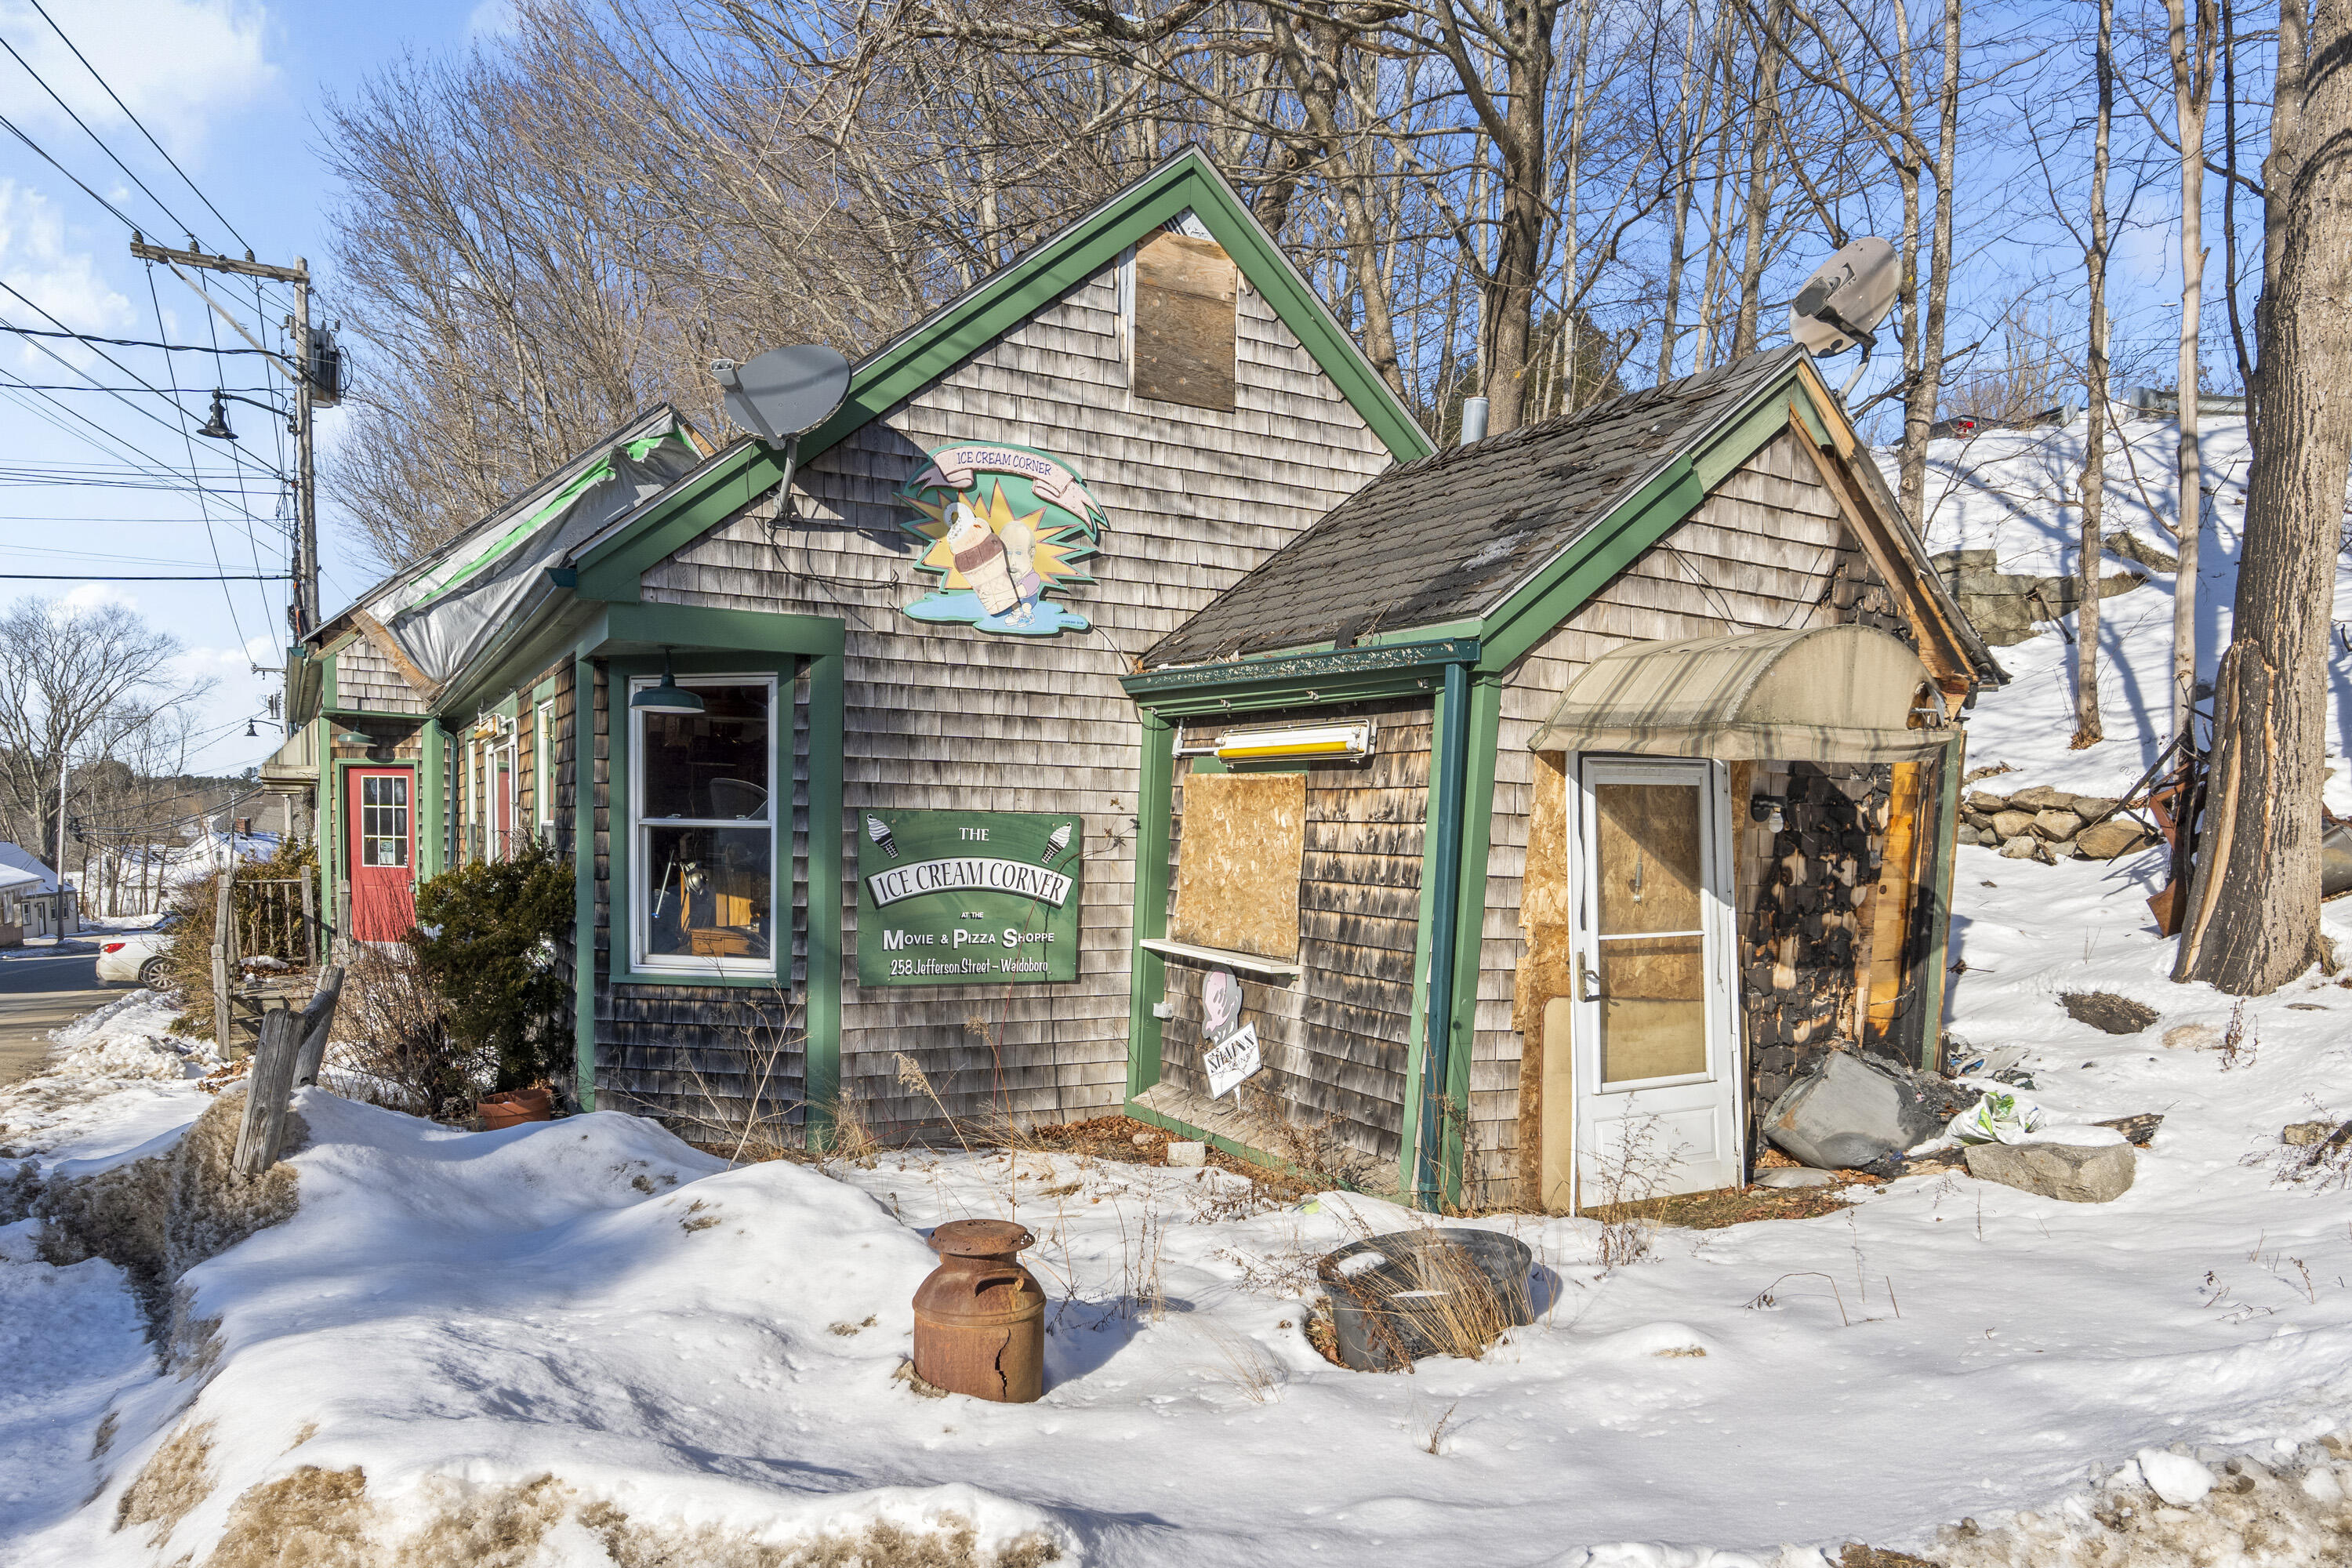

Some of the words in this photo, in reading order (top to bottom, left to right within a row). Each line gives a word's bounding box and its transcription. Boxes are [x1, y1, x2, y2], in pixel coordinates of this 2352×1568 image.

[956, 452, 973, 464] ICE
[975, 451, 1011, 466] CREAM
[1013, 455, 1051, 476] CORNER
[959, 827, 989, 841] THE
[877, 869, 913, 901] ICE
[916, 861, 983, 891] CREAM
[989, 862, 1064, 901] CORNER
[940, 934, 949, 945] &
[891, 959, 913, 975] 258
[913, 958, 960, 975] Jefferson
[961, 957, 990, 973] Street
[1000, 956, 1048, 973] Waldoboro
